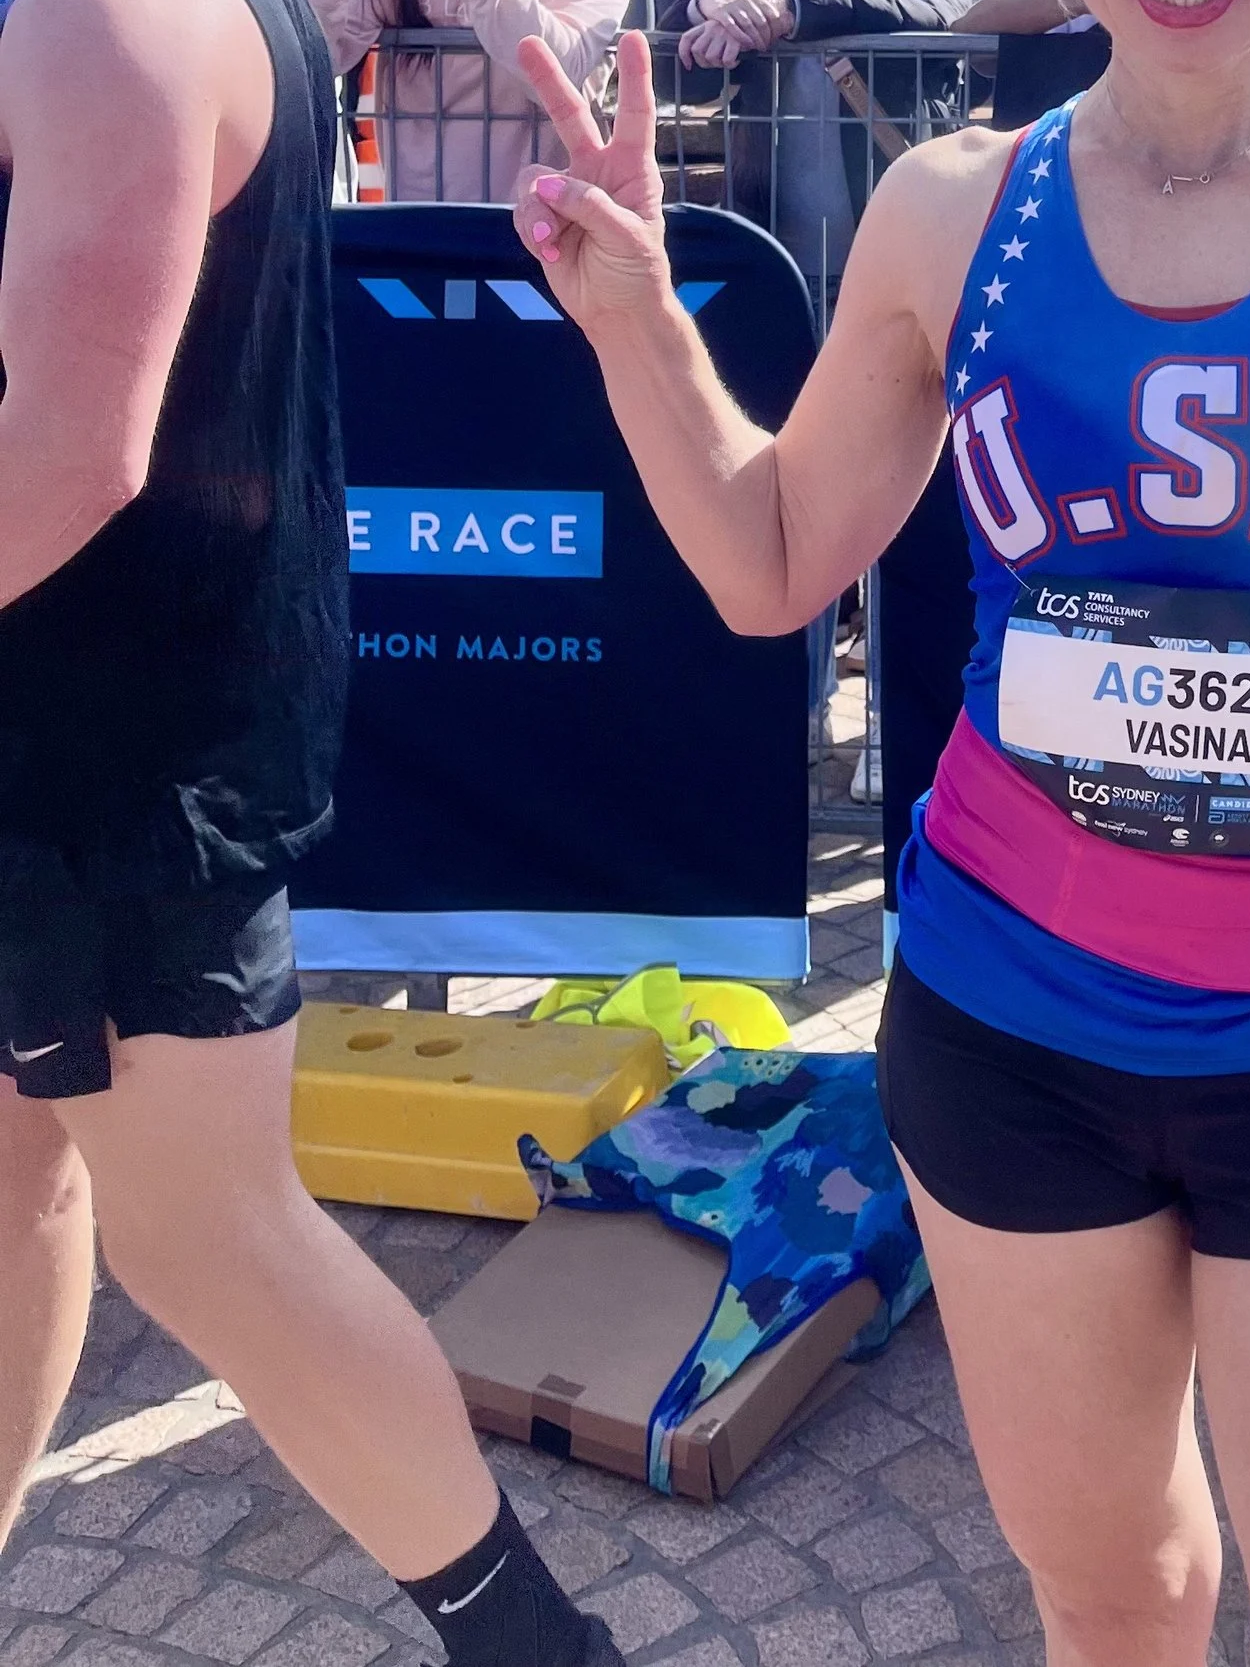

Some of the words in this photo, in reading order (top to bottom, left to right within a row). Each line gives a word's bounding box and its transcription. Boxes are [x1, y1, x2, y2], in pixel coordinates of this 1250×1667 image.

[410, 511, 578, 555] RACE
[1036, 587, 1081, 619] tcs
[1084, 601, 1150, 619] CONSULTANCY
[1087, 591, 1114, 604] TATA
[1083, 612, 1125, 626] SERVICES
[350, 632, 437, 659] HON
[457, 635, 603, 663] MAJORS
[1126, 719, 1250, 763] VASINA
[1068, 774, 1110, 805] tcs
[1112, 786, 1160, 803] SYDNEY
[1111, 798, 1186, 815] MARATHON
